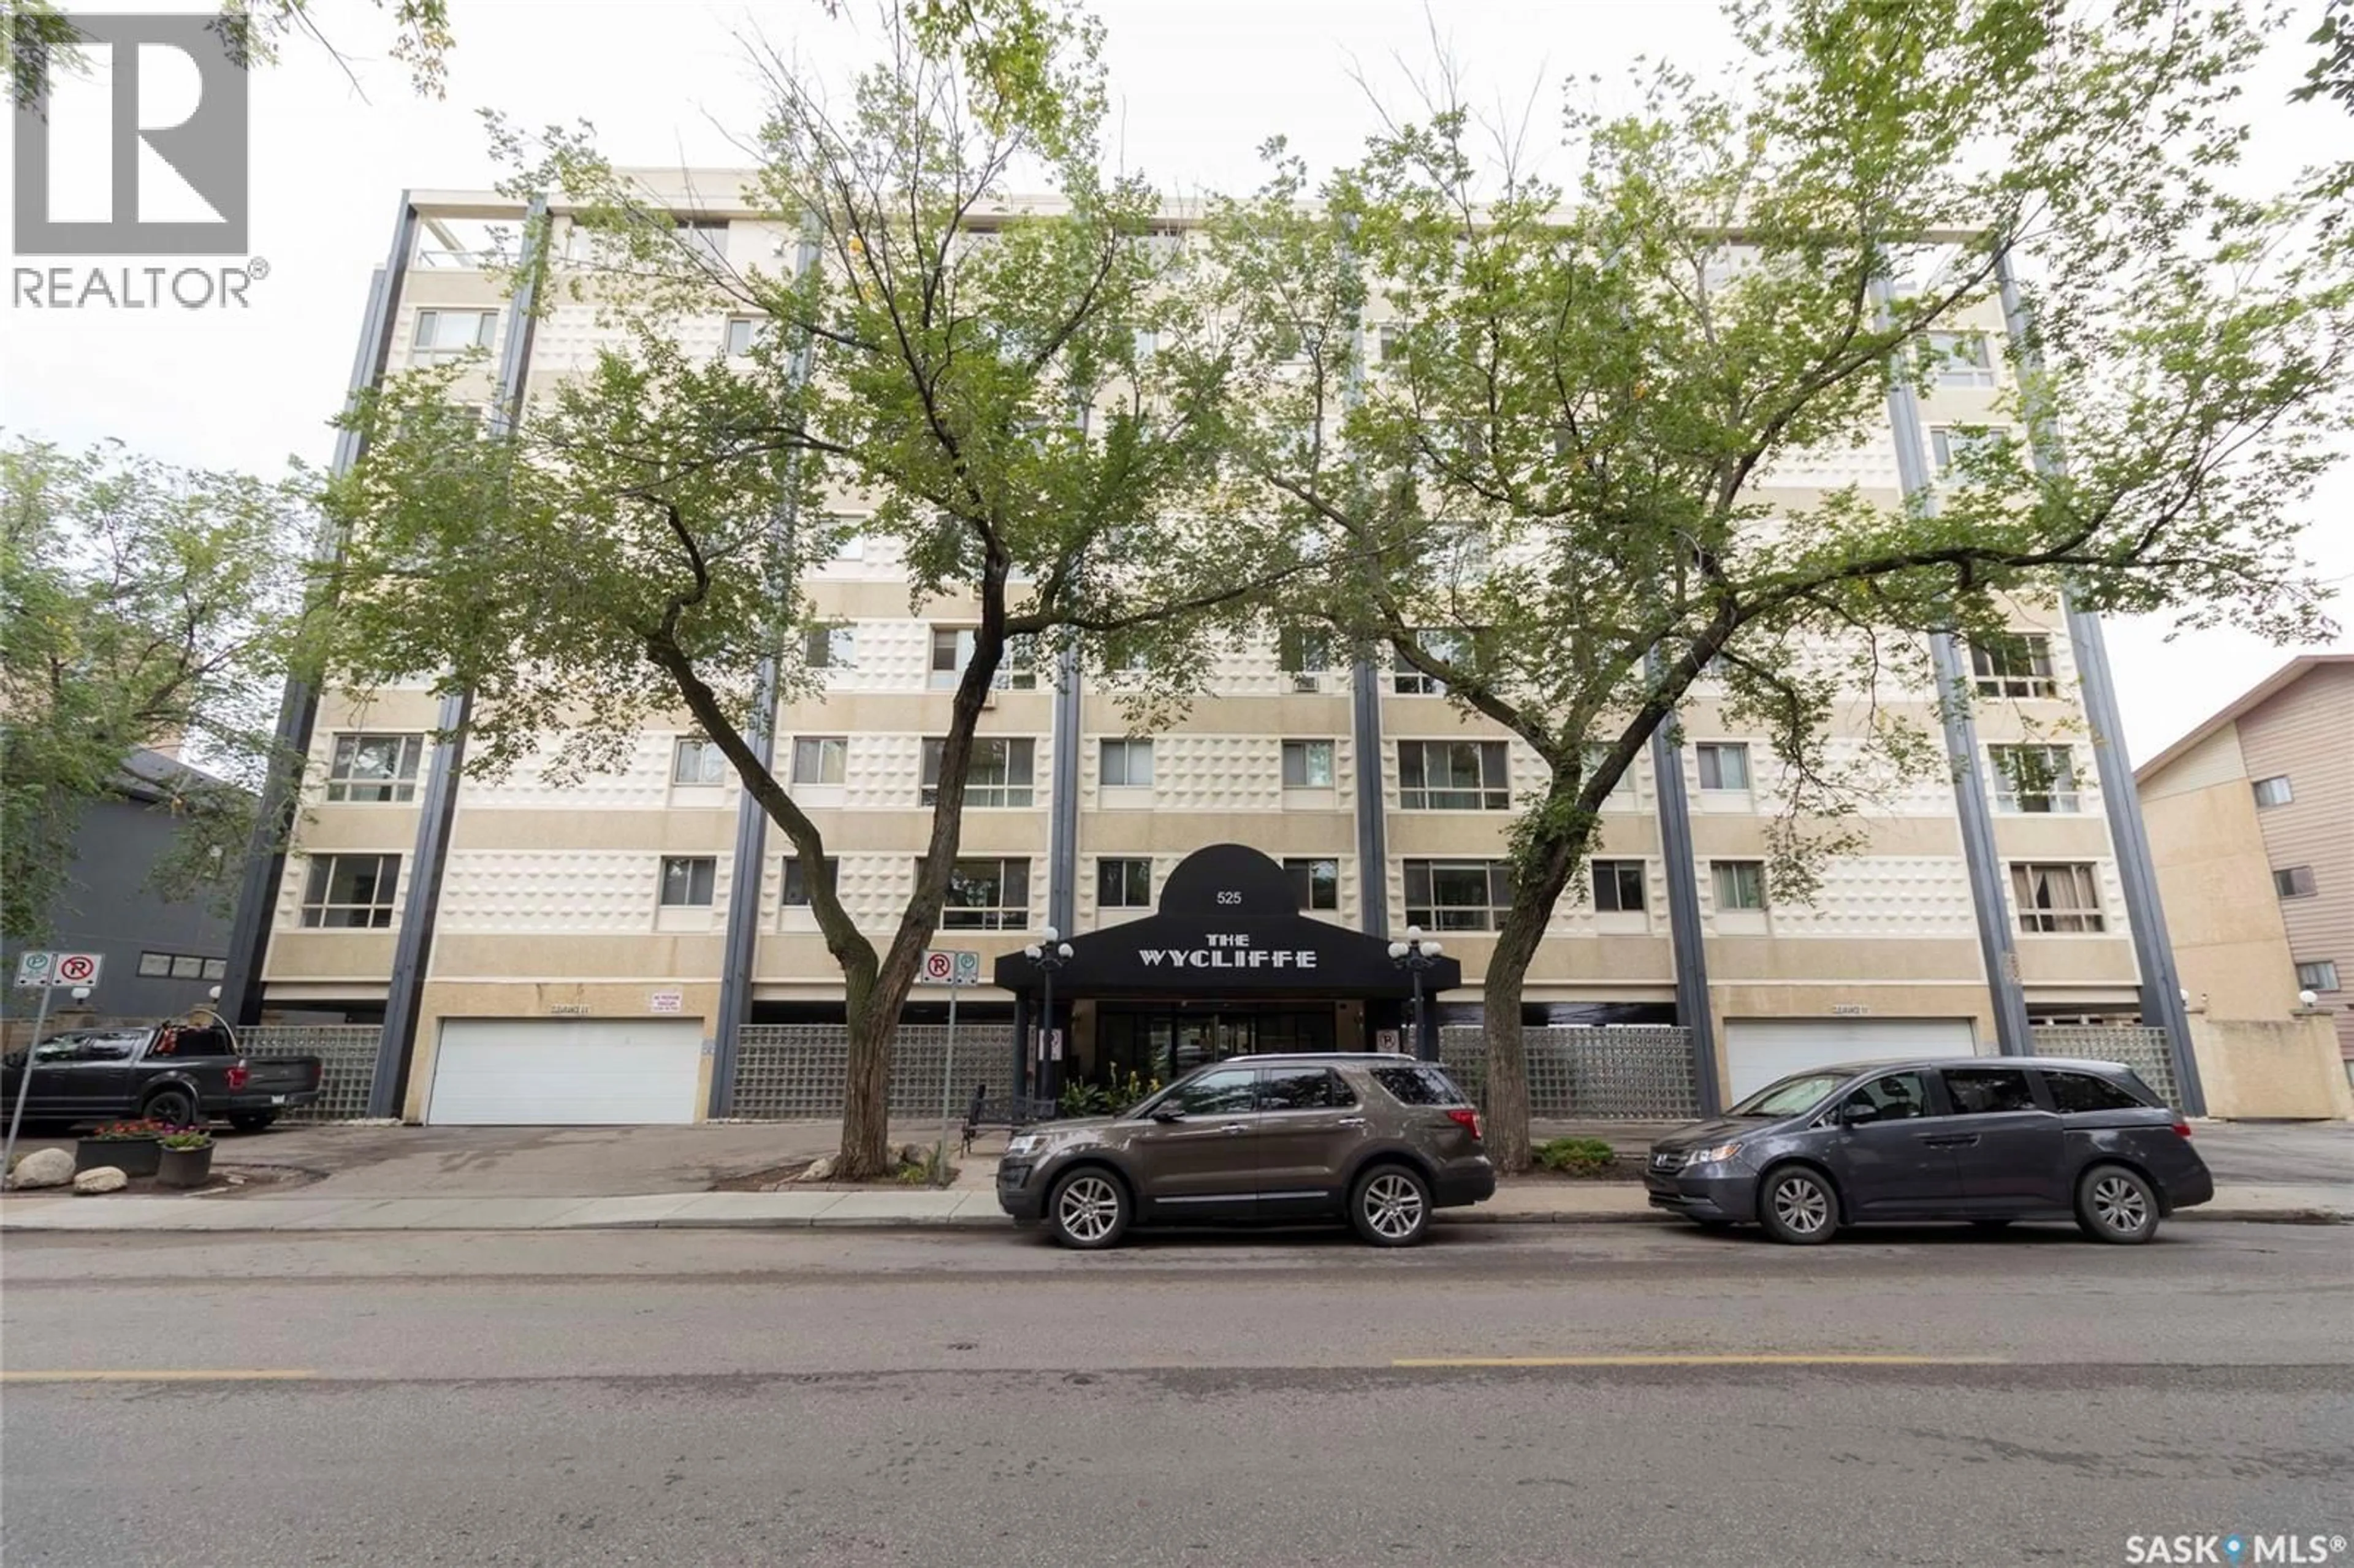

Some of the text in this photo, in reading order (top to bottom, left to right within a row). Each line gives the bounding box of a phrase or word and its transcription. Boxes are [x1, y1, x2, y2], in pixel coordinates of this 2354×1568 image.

[1217, 891, 1241, 904] 525
[1205, 934, 1250, 946] THE
[1138, 950, 1317, 967] WYCLIFFE
